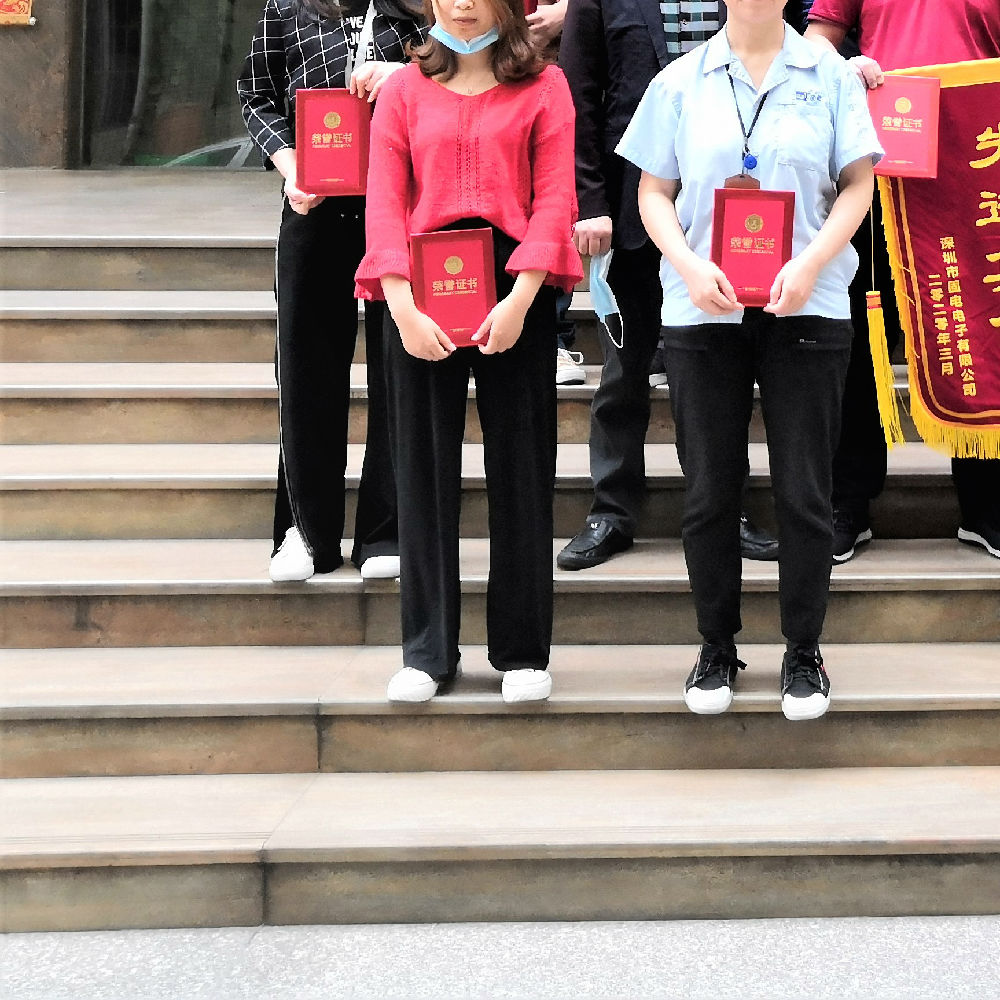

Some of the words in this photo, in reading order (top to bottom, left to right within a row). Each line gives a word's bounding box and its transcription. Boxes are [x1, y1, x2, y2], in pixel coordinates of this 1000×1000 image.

[928, 274, 953, 376] 二零二零年三月
